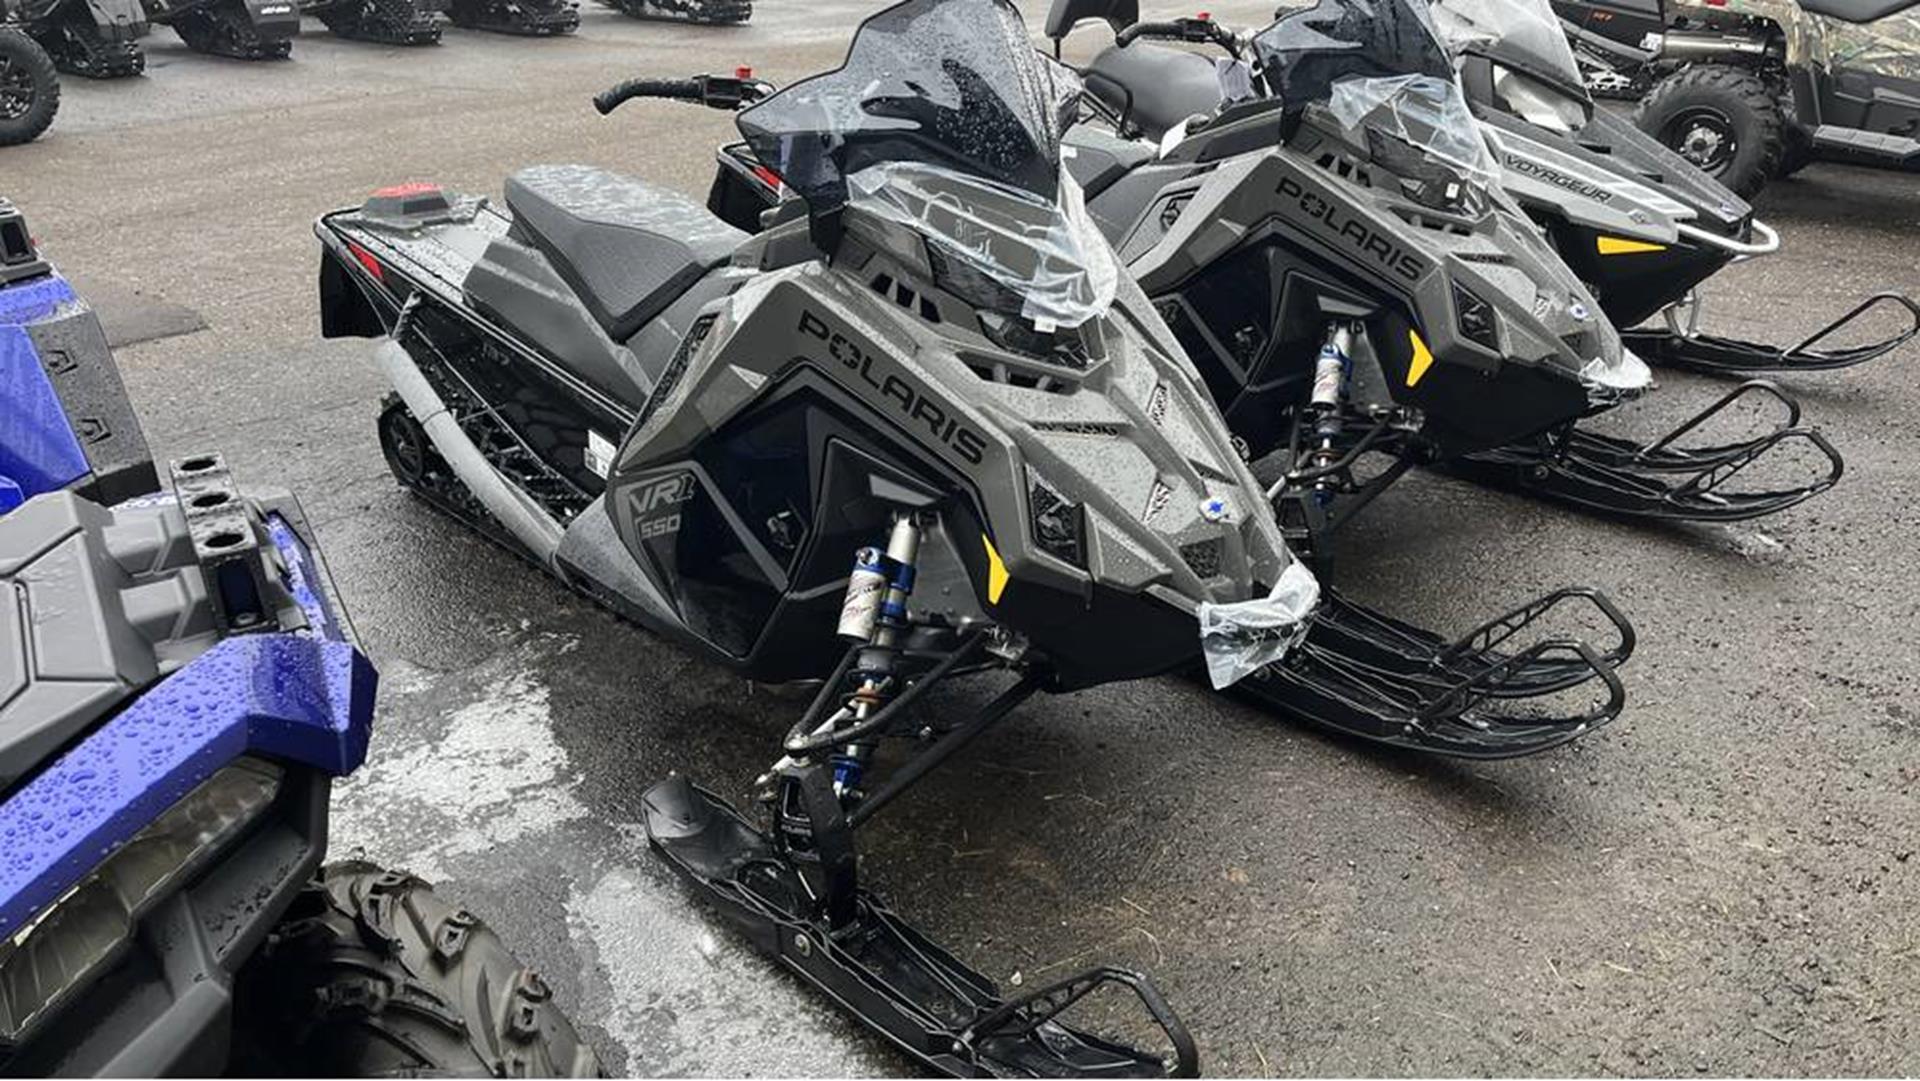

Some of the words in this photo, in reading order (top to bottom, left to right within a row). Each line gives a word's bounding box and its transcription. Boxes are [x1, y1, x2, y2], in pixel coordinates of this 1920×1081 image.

[1275, 177, 1424, 281] POLARIS
[1507, 155, 1612, 201] VOYAGEUR
[798, 309, 987, 465] POLARIS
